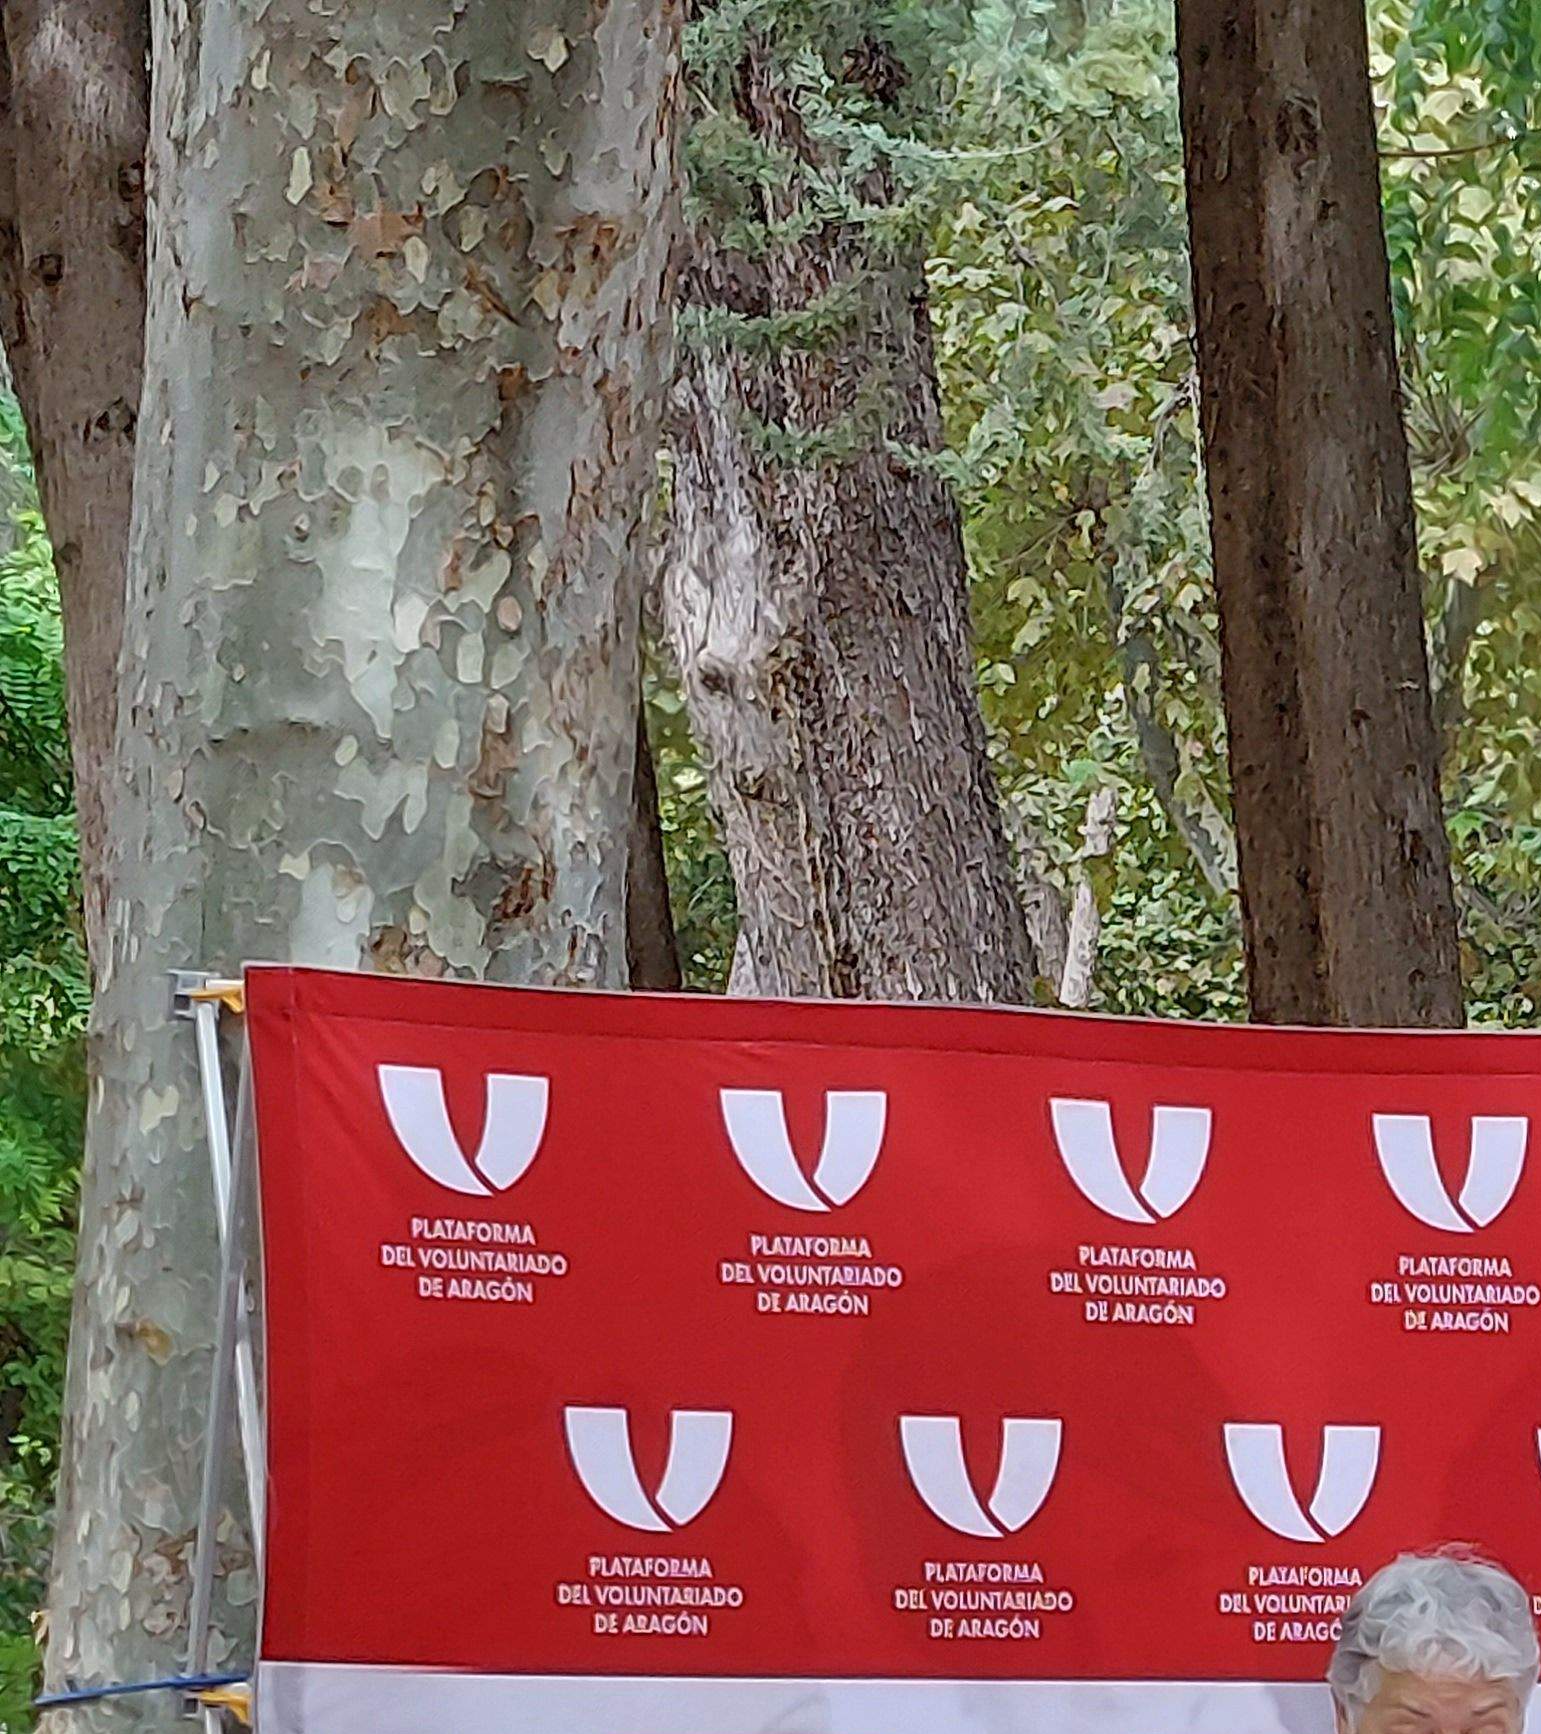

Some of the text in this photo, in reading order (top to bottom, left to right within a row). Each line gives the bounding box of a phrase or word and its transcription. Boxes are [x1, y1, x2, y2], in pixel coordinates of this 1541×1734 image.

[410, 1216, 537, 1247] PLATAFORMA
[379, 1243, 569, 1277] DEL VOLUNTARIADO
[749, 1233, 874, 1260] PLATAFORMA
[1077, 1244, 1198, 1272] PLATAFORMA
[719, 1261, 904, 1289] DEL VOLUNTARIADO
[1397, 1254, 1514, 1279] PLATAFORMA
[417, 1274, 535, 1304] DE ARAGÓN
[1083, 1271, 1227, 1300] VOLUNTARIADO
[1369, 1281, 1541, 1307] DEL VOLUNTARIADO
[756, 1288, 870, 1317] DE ARAGÓN
[1083, 1298, 1195, 1326] DE ARAGÓN
[1429, 1305, 1510, 1334] ARAGÓN
[587, 1555, 714, 1580] PLATAFORMA
[923, 1560, 1045, 1585] PLATAFORMA
[1247, 1565, 1364, 1588] PLATAFORMA
[556, 1581, 745, 1609] DEL VOLUNTARIADO
[893, 1587, 1074, 1613] DEL VOLUNTARIADO
[1218, 1591, 1352, 1615] DEL VOLUNTARI
[592, 1609, 709, 1637] DE ARAGÓN
[928, 1612, 1041, 1640] DE ARAGÓN
[1252, 1617, 1344, 1643] DE ARAGÓ
